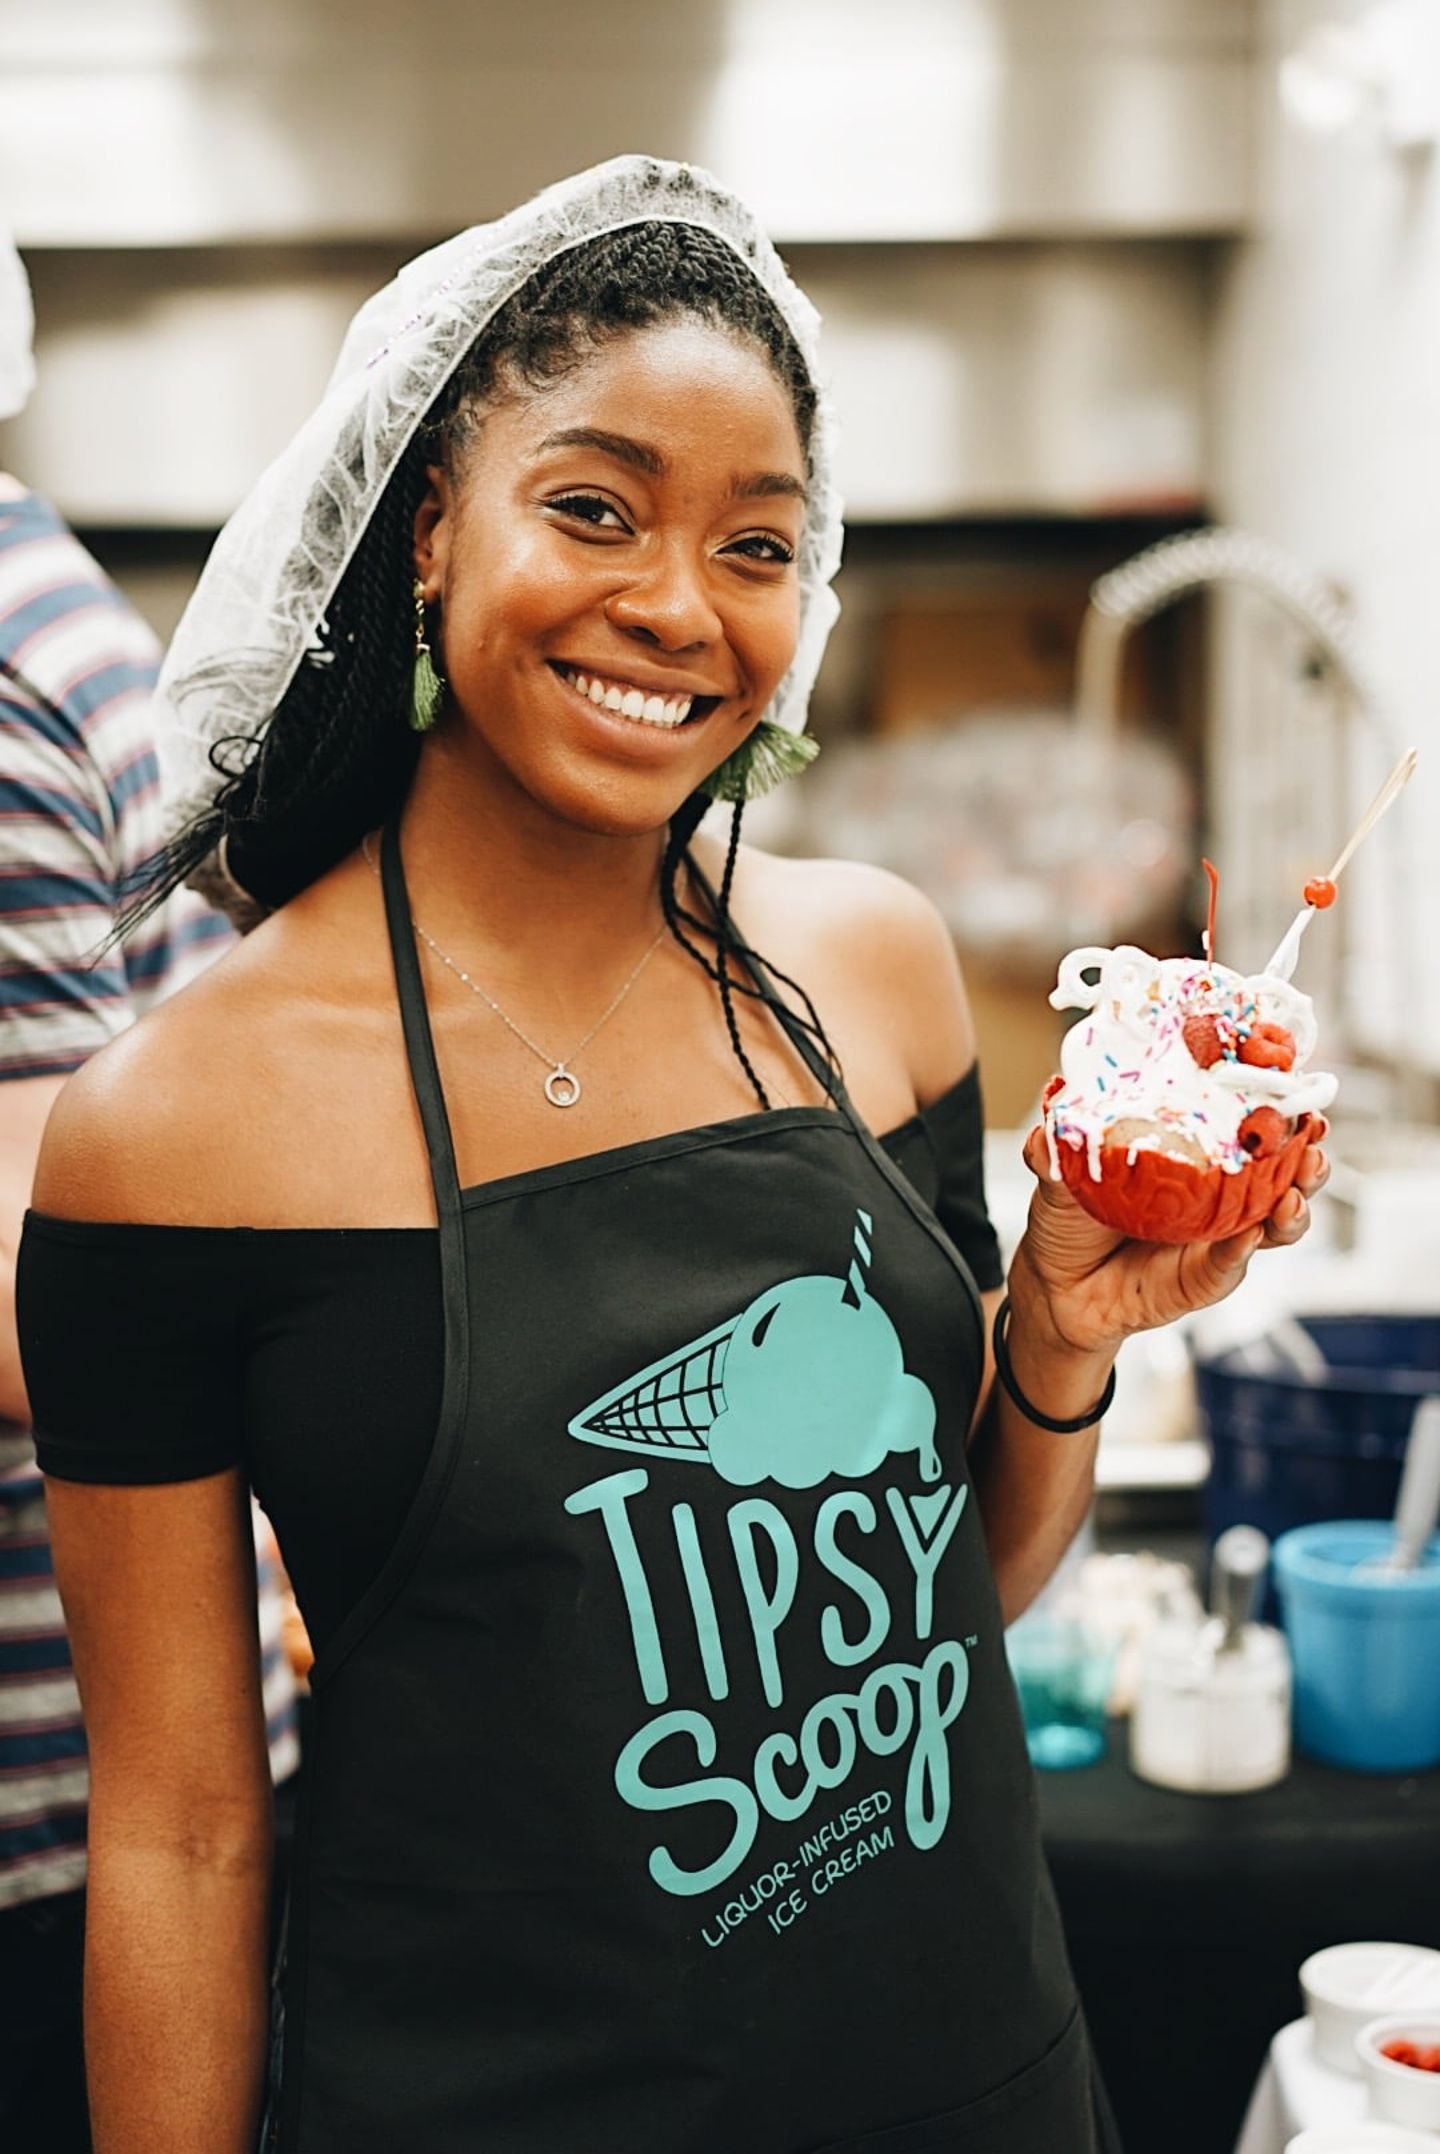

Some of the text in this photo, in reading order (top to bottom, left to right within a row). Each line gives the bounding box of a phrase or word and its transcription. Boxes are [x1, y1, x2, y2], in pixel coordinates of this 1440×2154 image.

[564, 1468, 968, 1708] TIPSY
[614, 1640, 969, 1897] Scoop
[701, 1790, 893, 1947] LIQUOR-INFUSED
[767, 1825, 895, 1935] ICE CREAM
